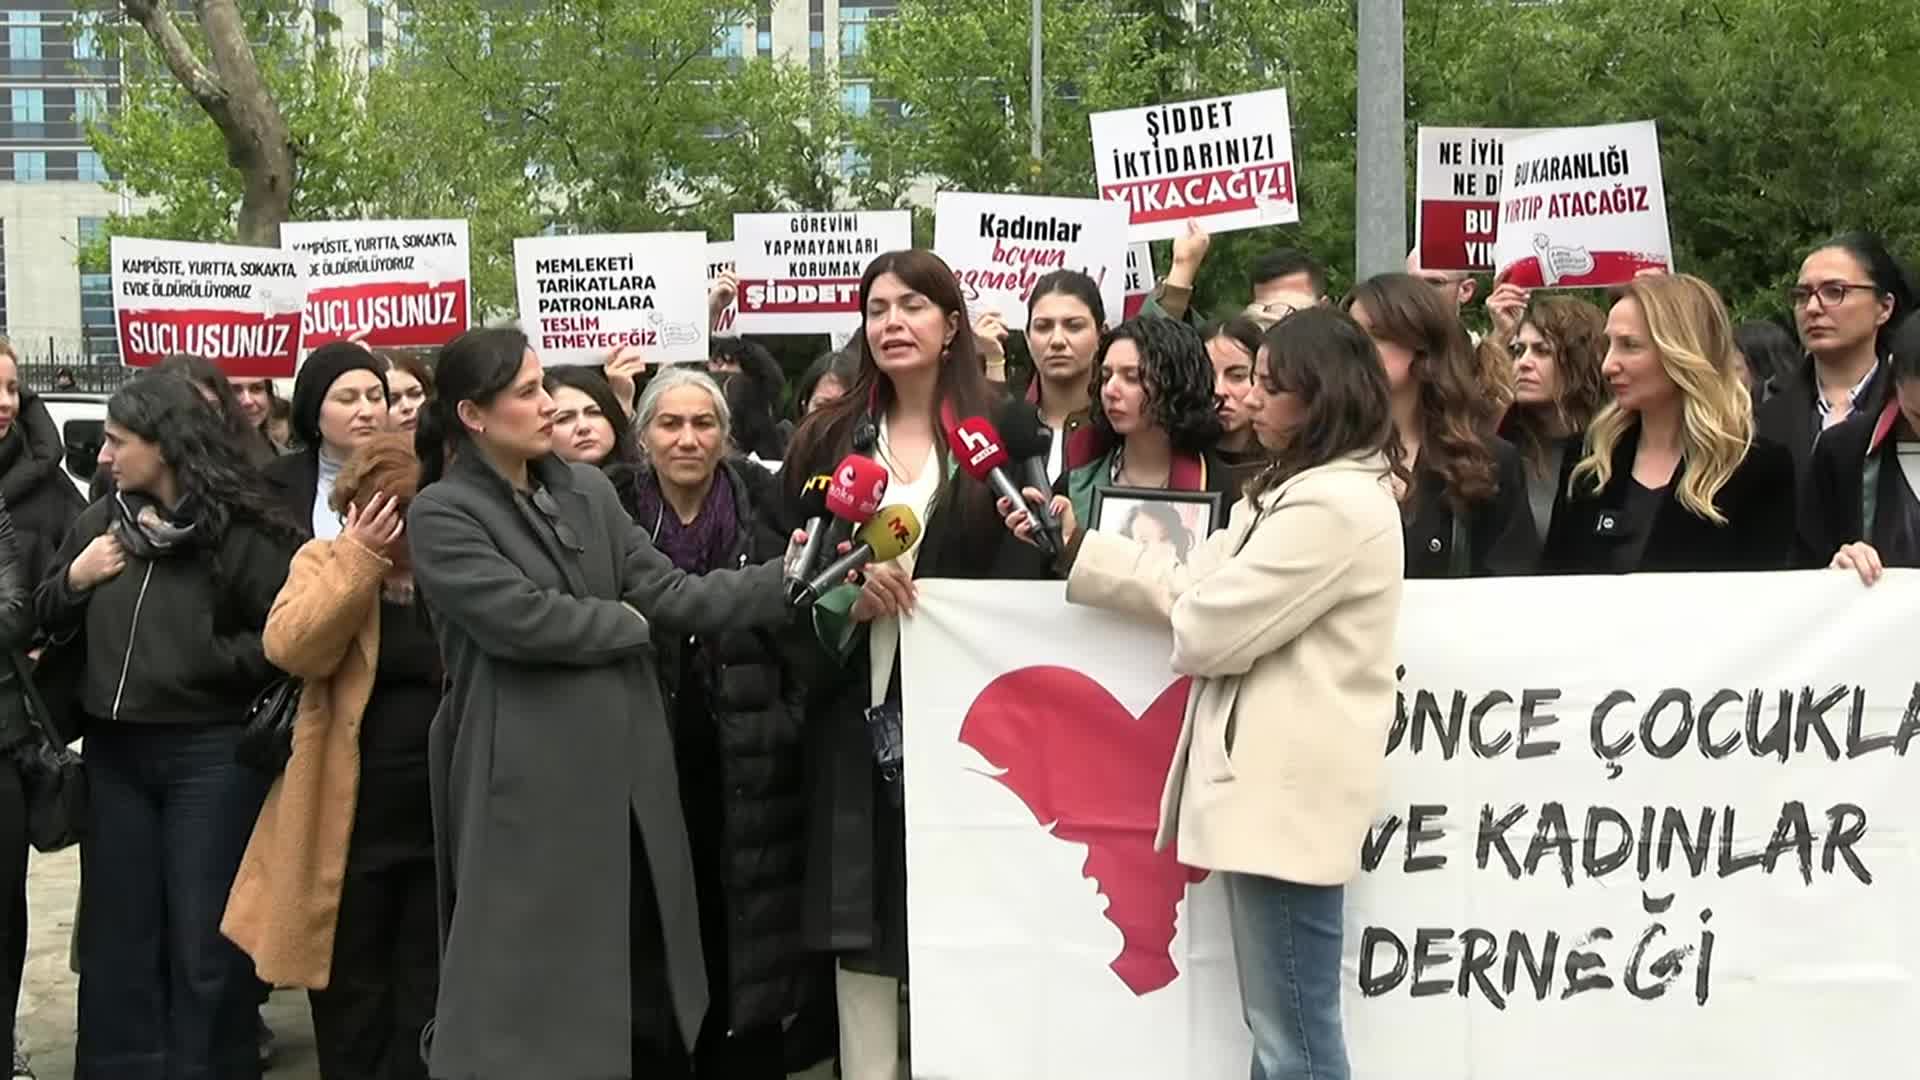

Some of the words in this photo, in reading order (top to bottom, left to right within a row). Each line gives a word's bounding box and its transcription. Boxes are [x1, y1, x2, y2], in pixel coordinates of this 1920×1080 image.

[1145, 101, 1232, 146] ŞİDDET
[1113, 133, 1274, 179] İKTİDARINIZI
[1440, 142, 1462, 165] NE
[1514, 161, 1529, 188] BU
[1530, 145, 1629, 183] KARANLIĞI
[1107, 166, 1287, 213] YIKACAĞIZ!
[1453, 173, 1476, 196] NE
[1504, 195, 1544, 224] YIRTIP
[1548, 183, 1650, 219] ATACAĞIZ
[790, 214, 859, 233] GÖREVİNİ
[979, 212, 1082, 242] Kadınlar
[1465, 209, 1493, 234] BU
[402, 232, 457, 249] SOKAKTA,
[764, 238, 879, 255] YAPMAYANLARI
[240, 262, 297, 278] SOKAKTA,
[535, 252, 634, 275] MEMLEKETİ
[789, 261, 861, 278] KORUMAK
[123, 281, 150, 297] EVDE
[152, 279, 252, 299] ÖLDÜRÜLÜYORUZ
[537, 274, 656, 294] TARİKATLARA
[746, 279, 861, 309] ŞİDDET
[303, 291, 457, 337] SUÇLUSUNUZ
[539, 294, 655, 313] PATRONLARA
[540, 313, 600, 333] TESLİM
[542, 328, 657, 350] ETMEYECEĞİZ
[1475, 800, 1873, 889] KADINLAR
[1358, 890, 1715, 1011] DERNEĞİ
